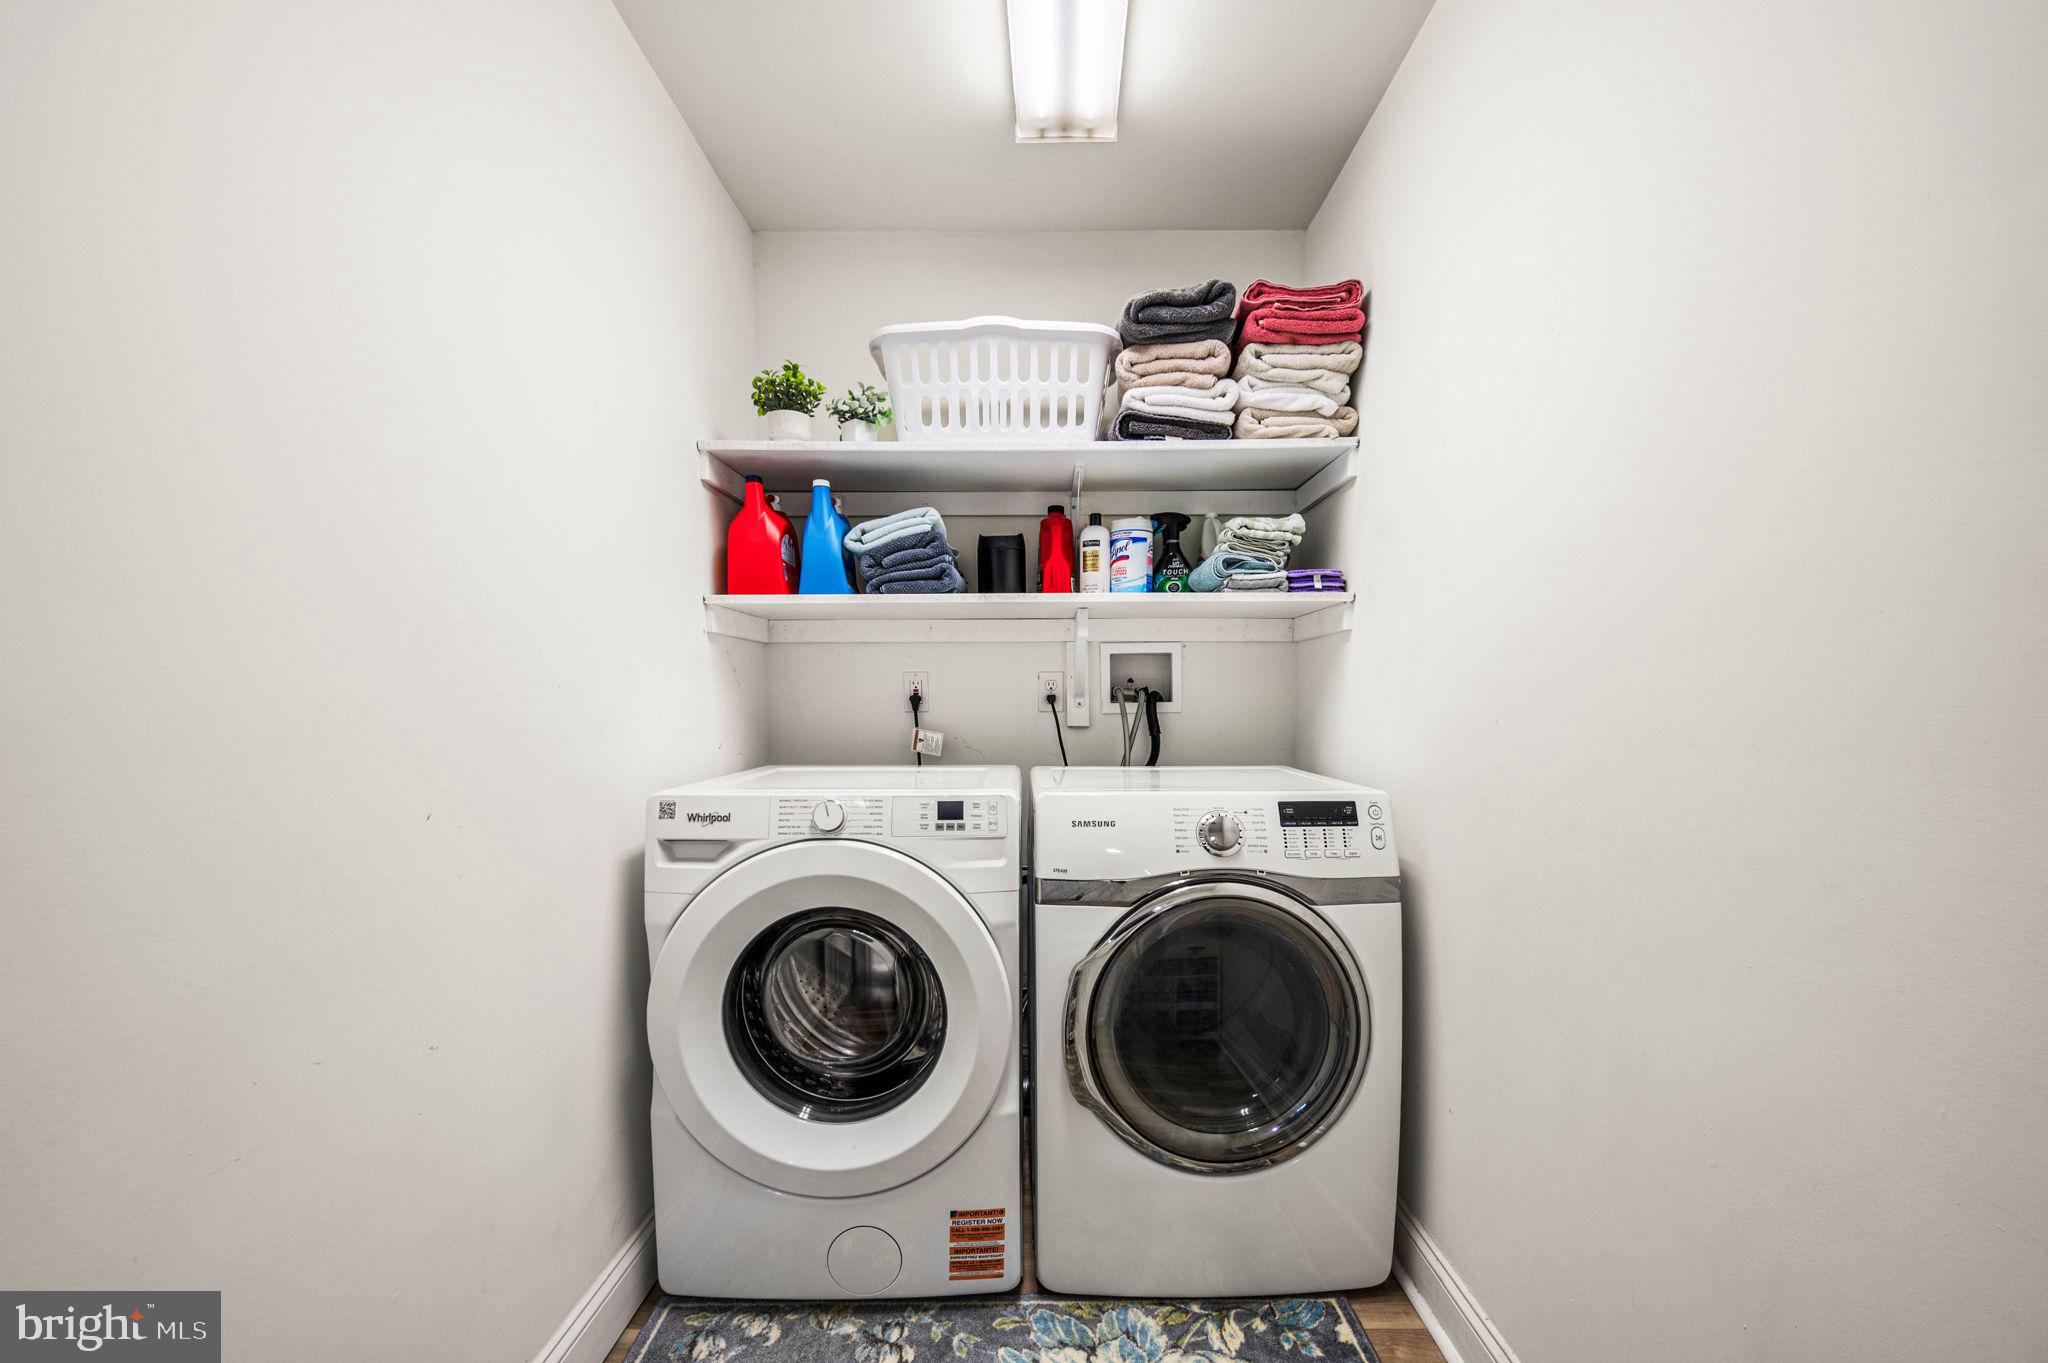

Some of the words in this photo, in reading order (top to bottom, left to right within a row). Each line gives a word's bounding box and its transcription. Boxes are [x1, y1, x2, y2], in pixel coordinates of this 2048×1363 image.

[1162, 568, 1189, 576] TOUCH
[687, 812, 731, 825] Whirlpool
[1071, 820, 1116, 828] SAMSUNG
[958, 1209, 999, 1217] IMPORTANT!
[954, 1247, 999, 1255] IMPORTANTE!
